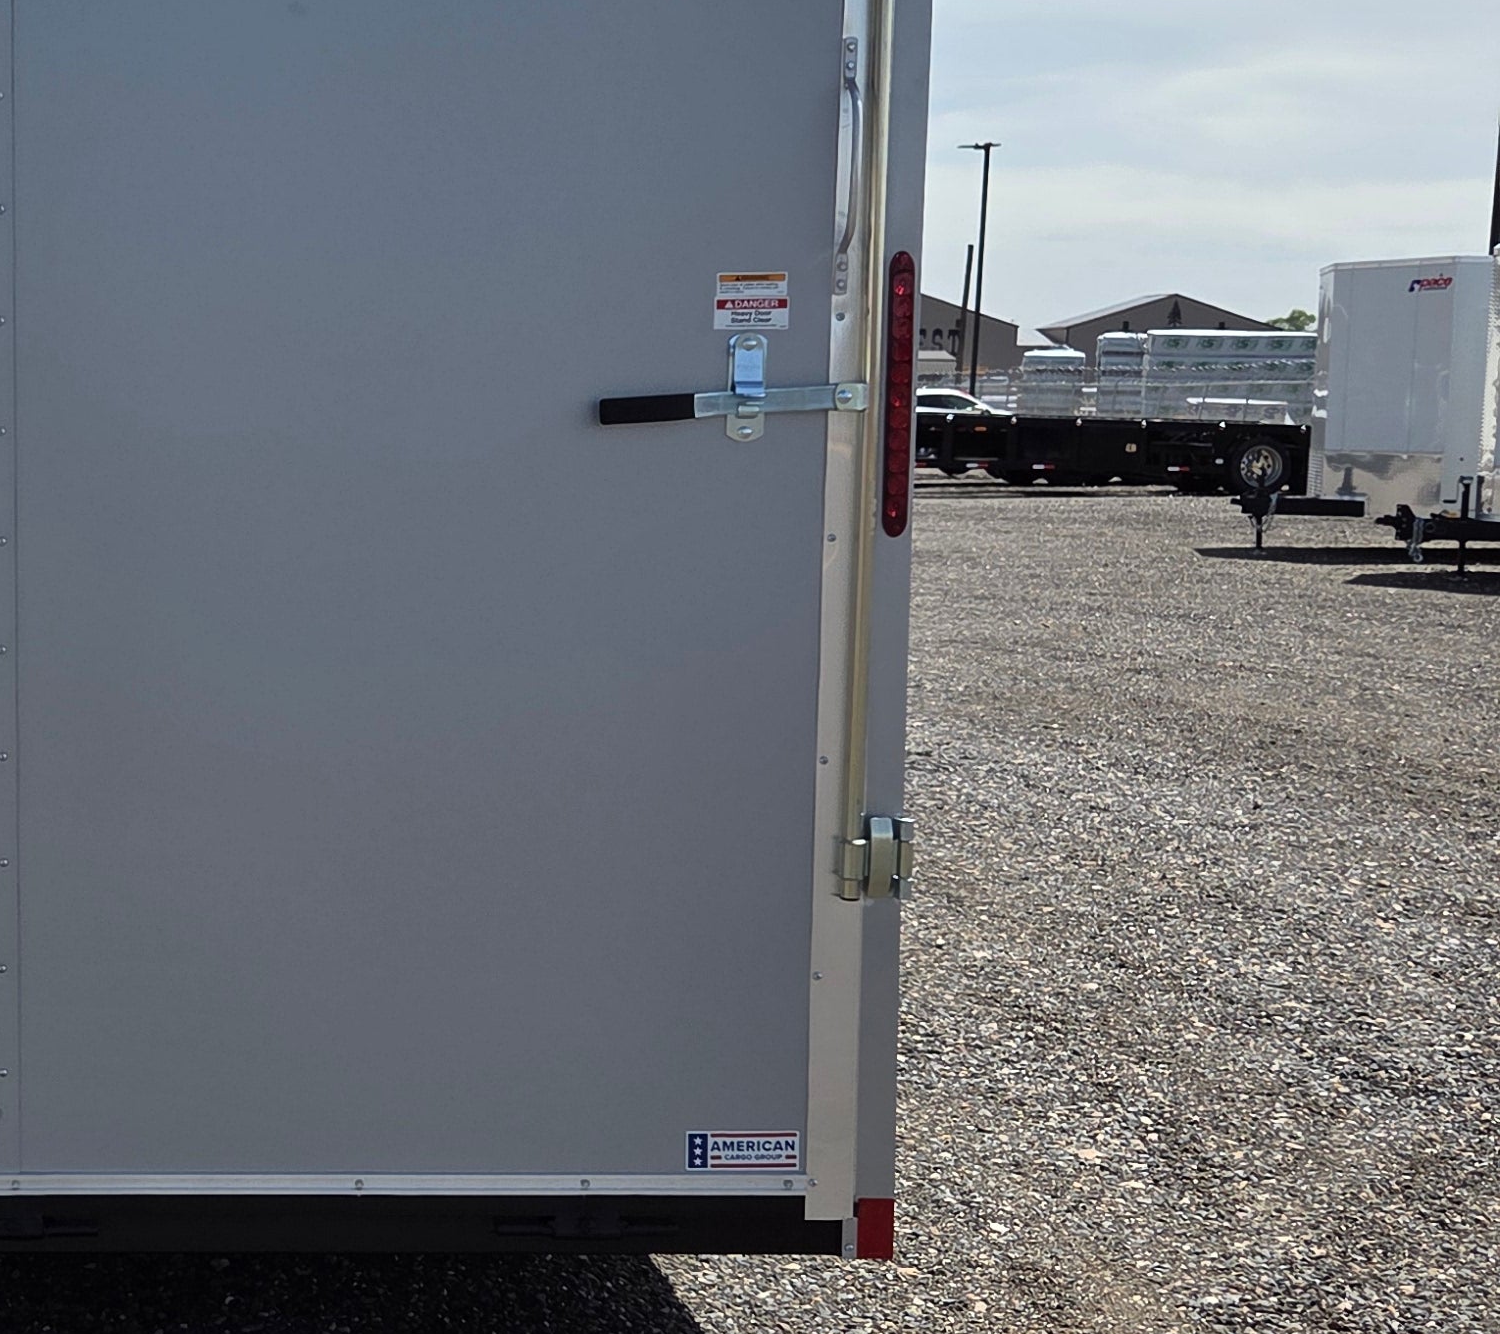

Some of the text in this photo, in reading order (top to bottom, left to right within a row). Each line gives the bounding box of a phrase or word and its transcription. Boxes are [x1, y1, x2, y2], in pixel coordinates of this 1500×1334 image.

[734, 299, 779, 308] DANGER
[731, 311, 752, 319] Heavy
[710, 1140, 795, 1152] AMERICAN
